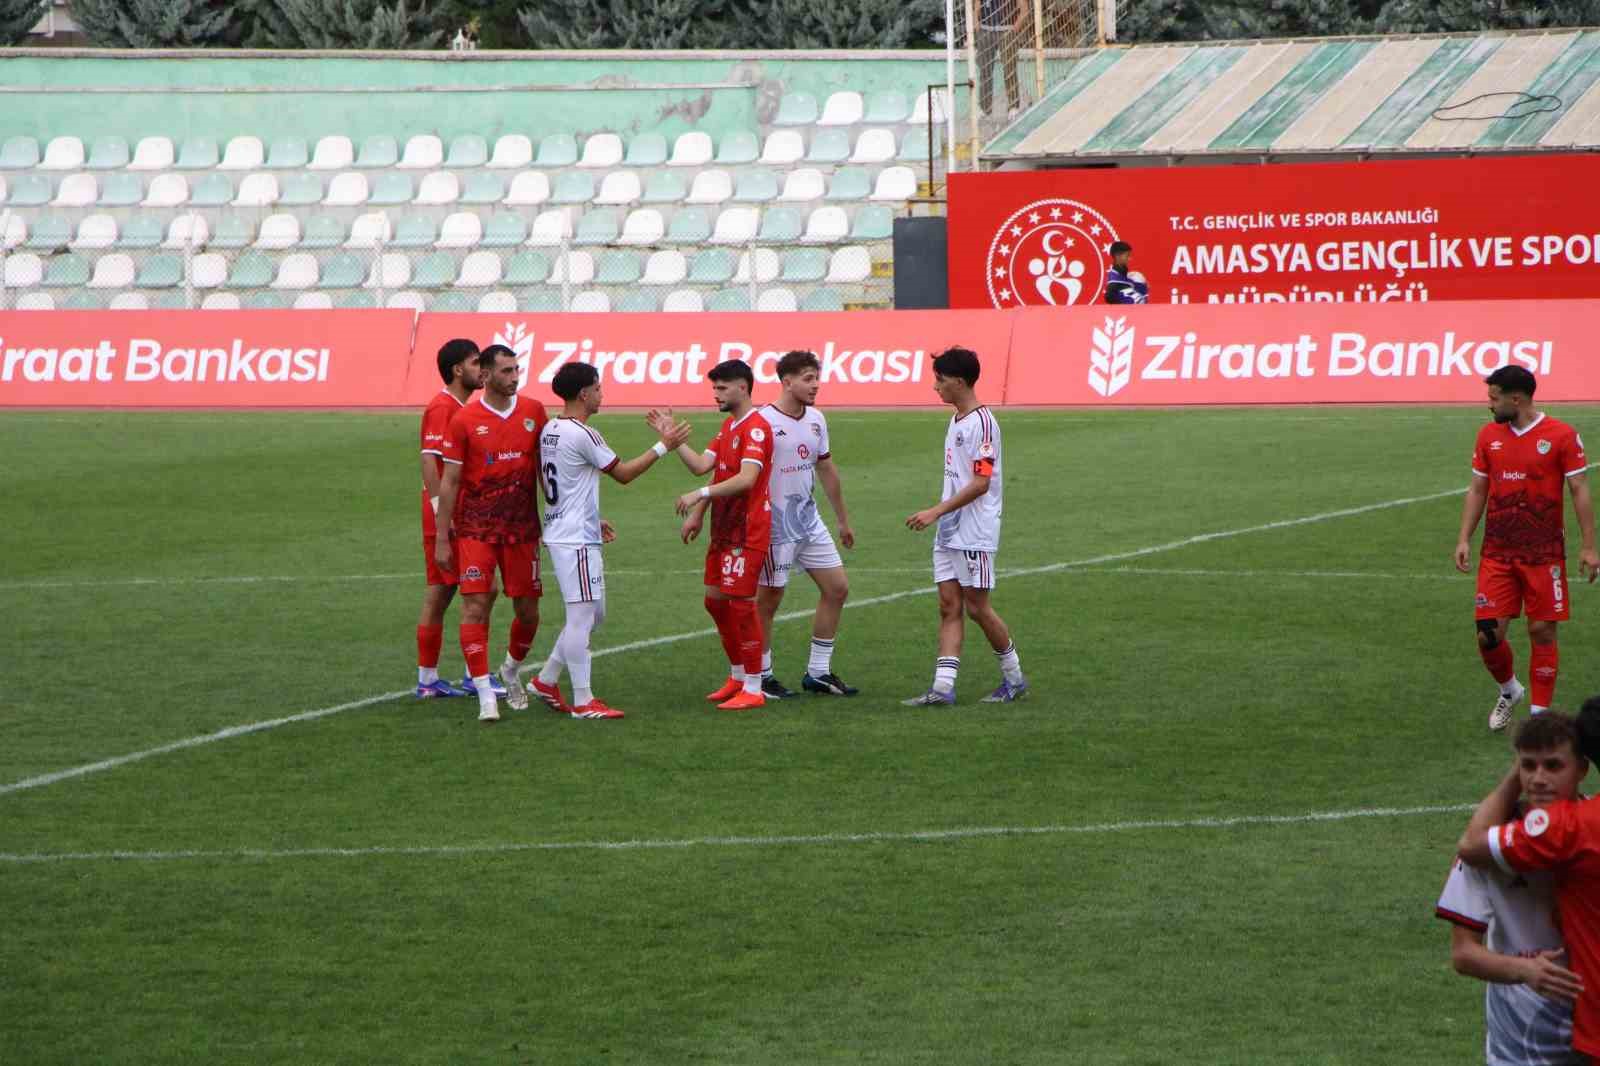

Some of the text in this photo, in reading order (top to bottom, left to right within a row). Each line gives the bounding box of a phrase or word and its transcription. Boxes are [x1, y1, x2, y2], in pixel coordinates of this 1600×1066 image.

[1169, 207, 1439, 233] T.C. GENÇLİK VE SPOR BAKANLIĞI
[1170, 242, 1313, 275] AMASYA
[1315, 232, 1464, 278] GENÇLİK
[1468, 236, 1514, 268] VE
[0, 336, 331, 383] raat Bankası
[1140, 331, 1553, 380] Ziraat Bankası
[722, 554, 746, 577] 34
